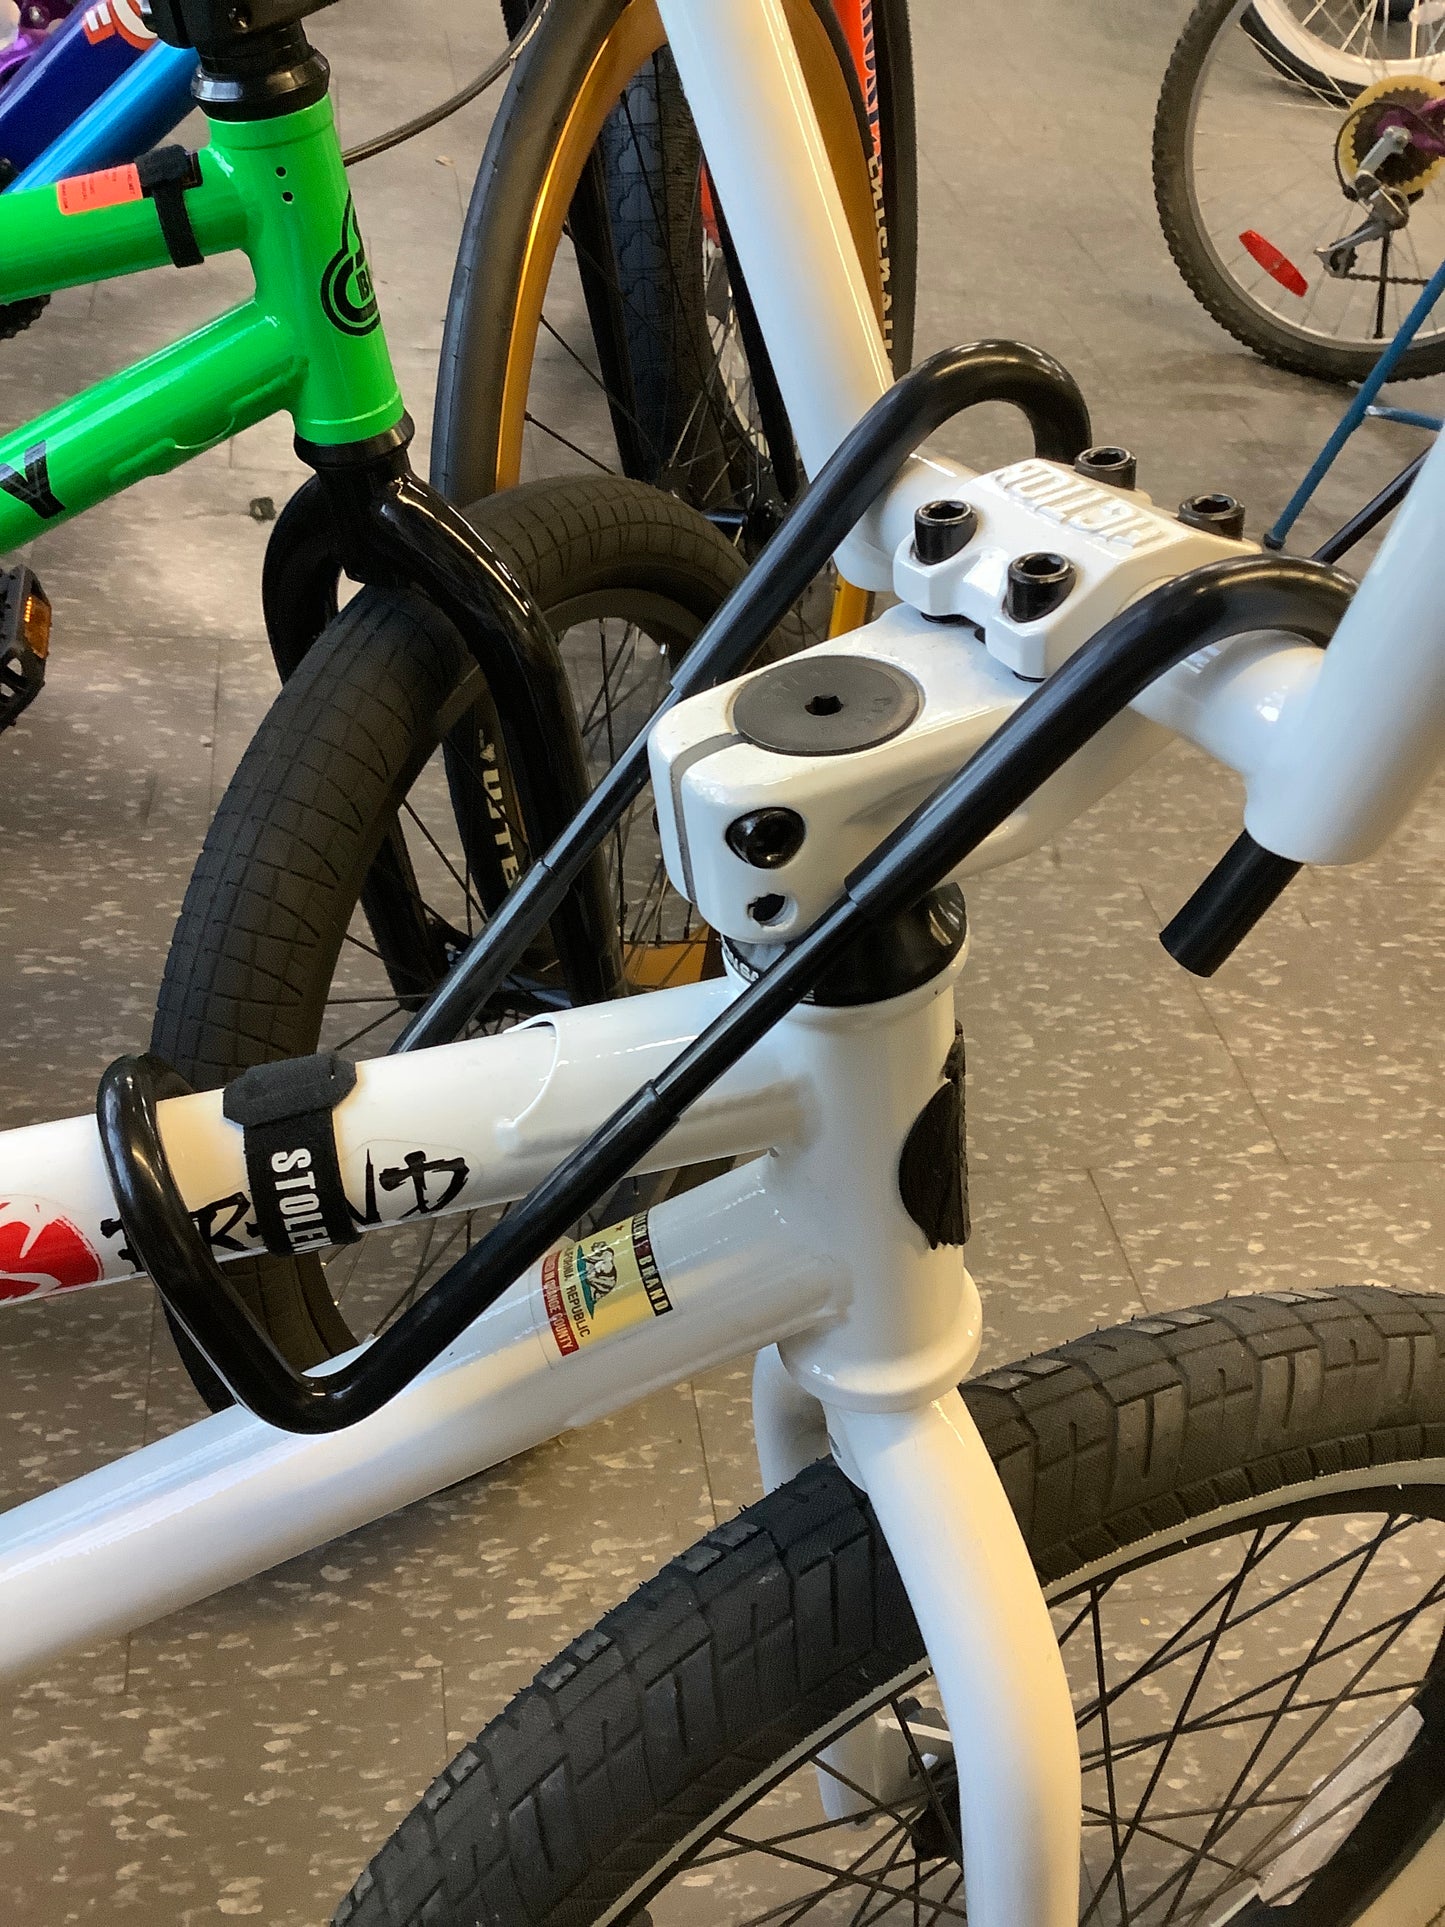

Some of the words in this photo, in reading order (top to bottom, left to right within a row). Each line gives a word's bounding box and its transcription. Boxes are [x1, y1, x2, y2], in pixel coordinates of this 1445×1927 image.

[271, 1148, 333, 1255] STOLEN
[639, 1255, 669, 1311] BRAND
[552, 1312, 574, 1349] COUNTY
[566, 1285, 591, 1338] REPUBLIC
